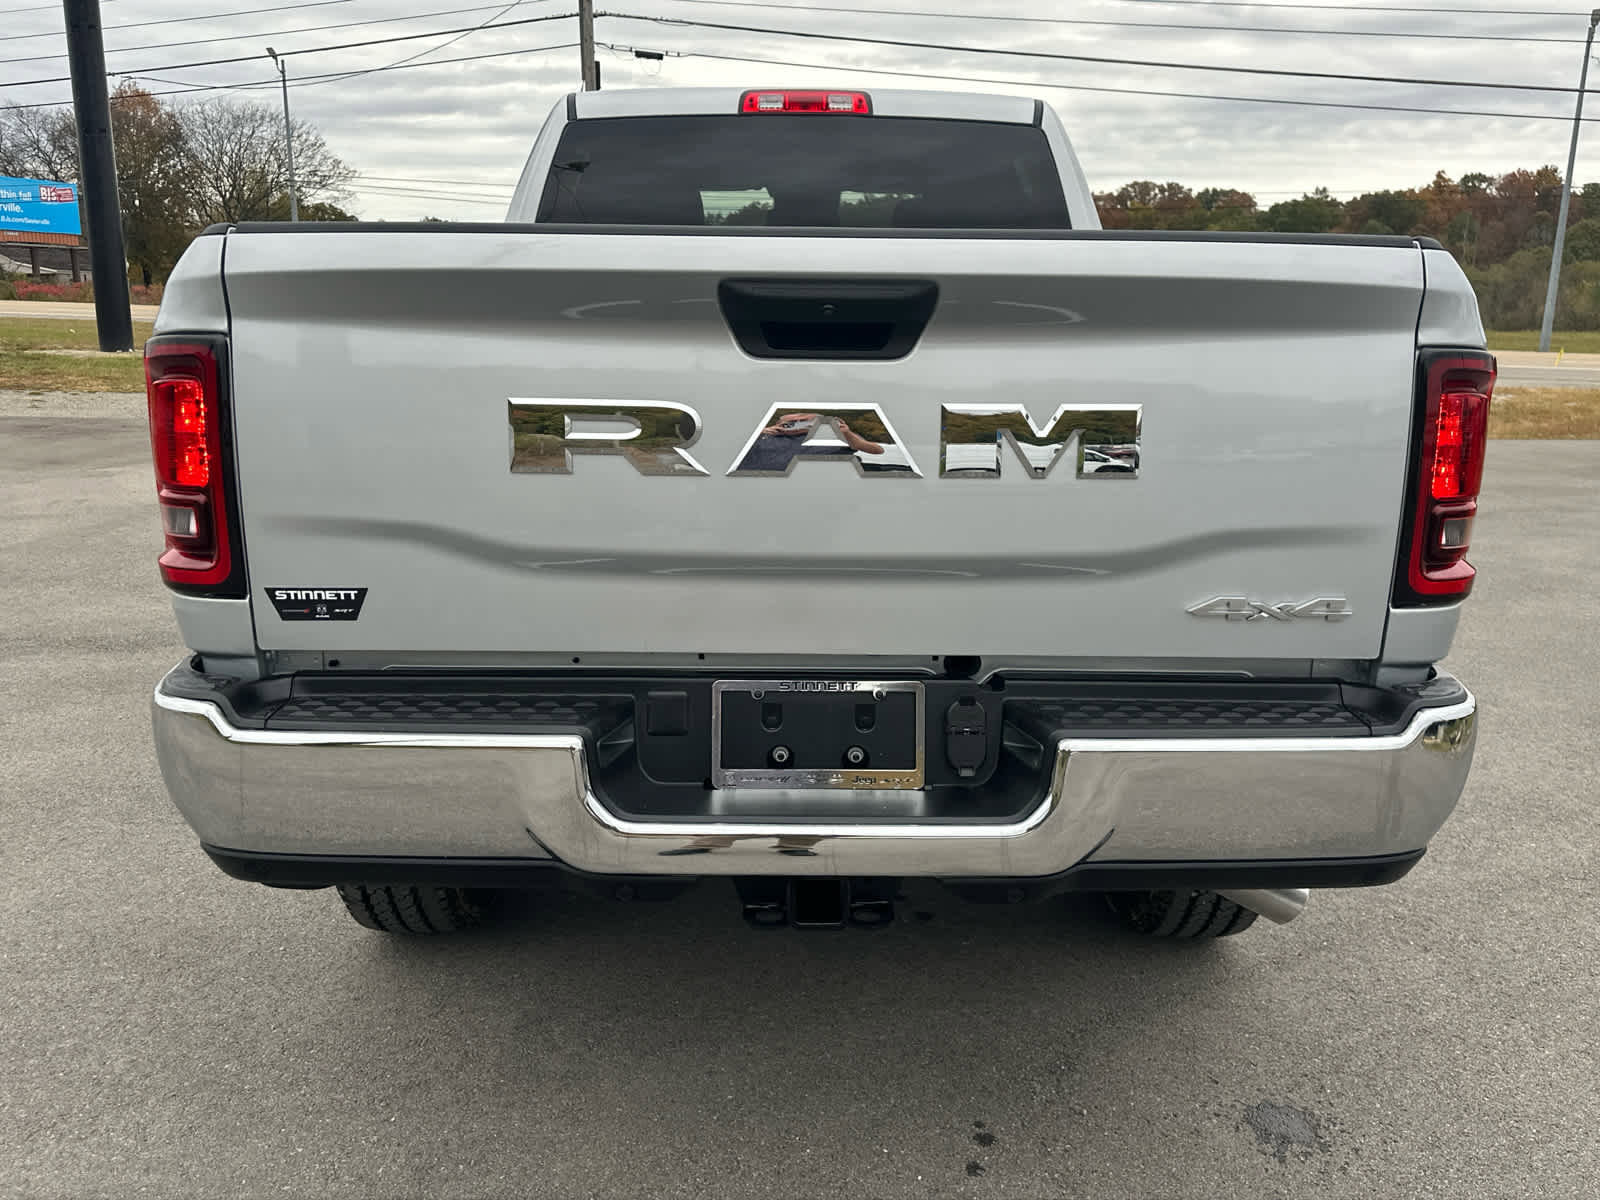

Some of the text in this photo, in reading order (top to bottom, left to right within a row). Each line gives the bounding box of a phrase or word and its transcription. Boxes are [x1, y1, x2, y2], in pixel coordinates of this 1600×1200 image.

[508, 398, 1143, 479] RAM
[275, 590, 358, 600] STINNETT
[779, 681, 858, 691] STINNETT
[852, 775, 877, 785] Jeep
